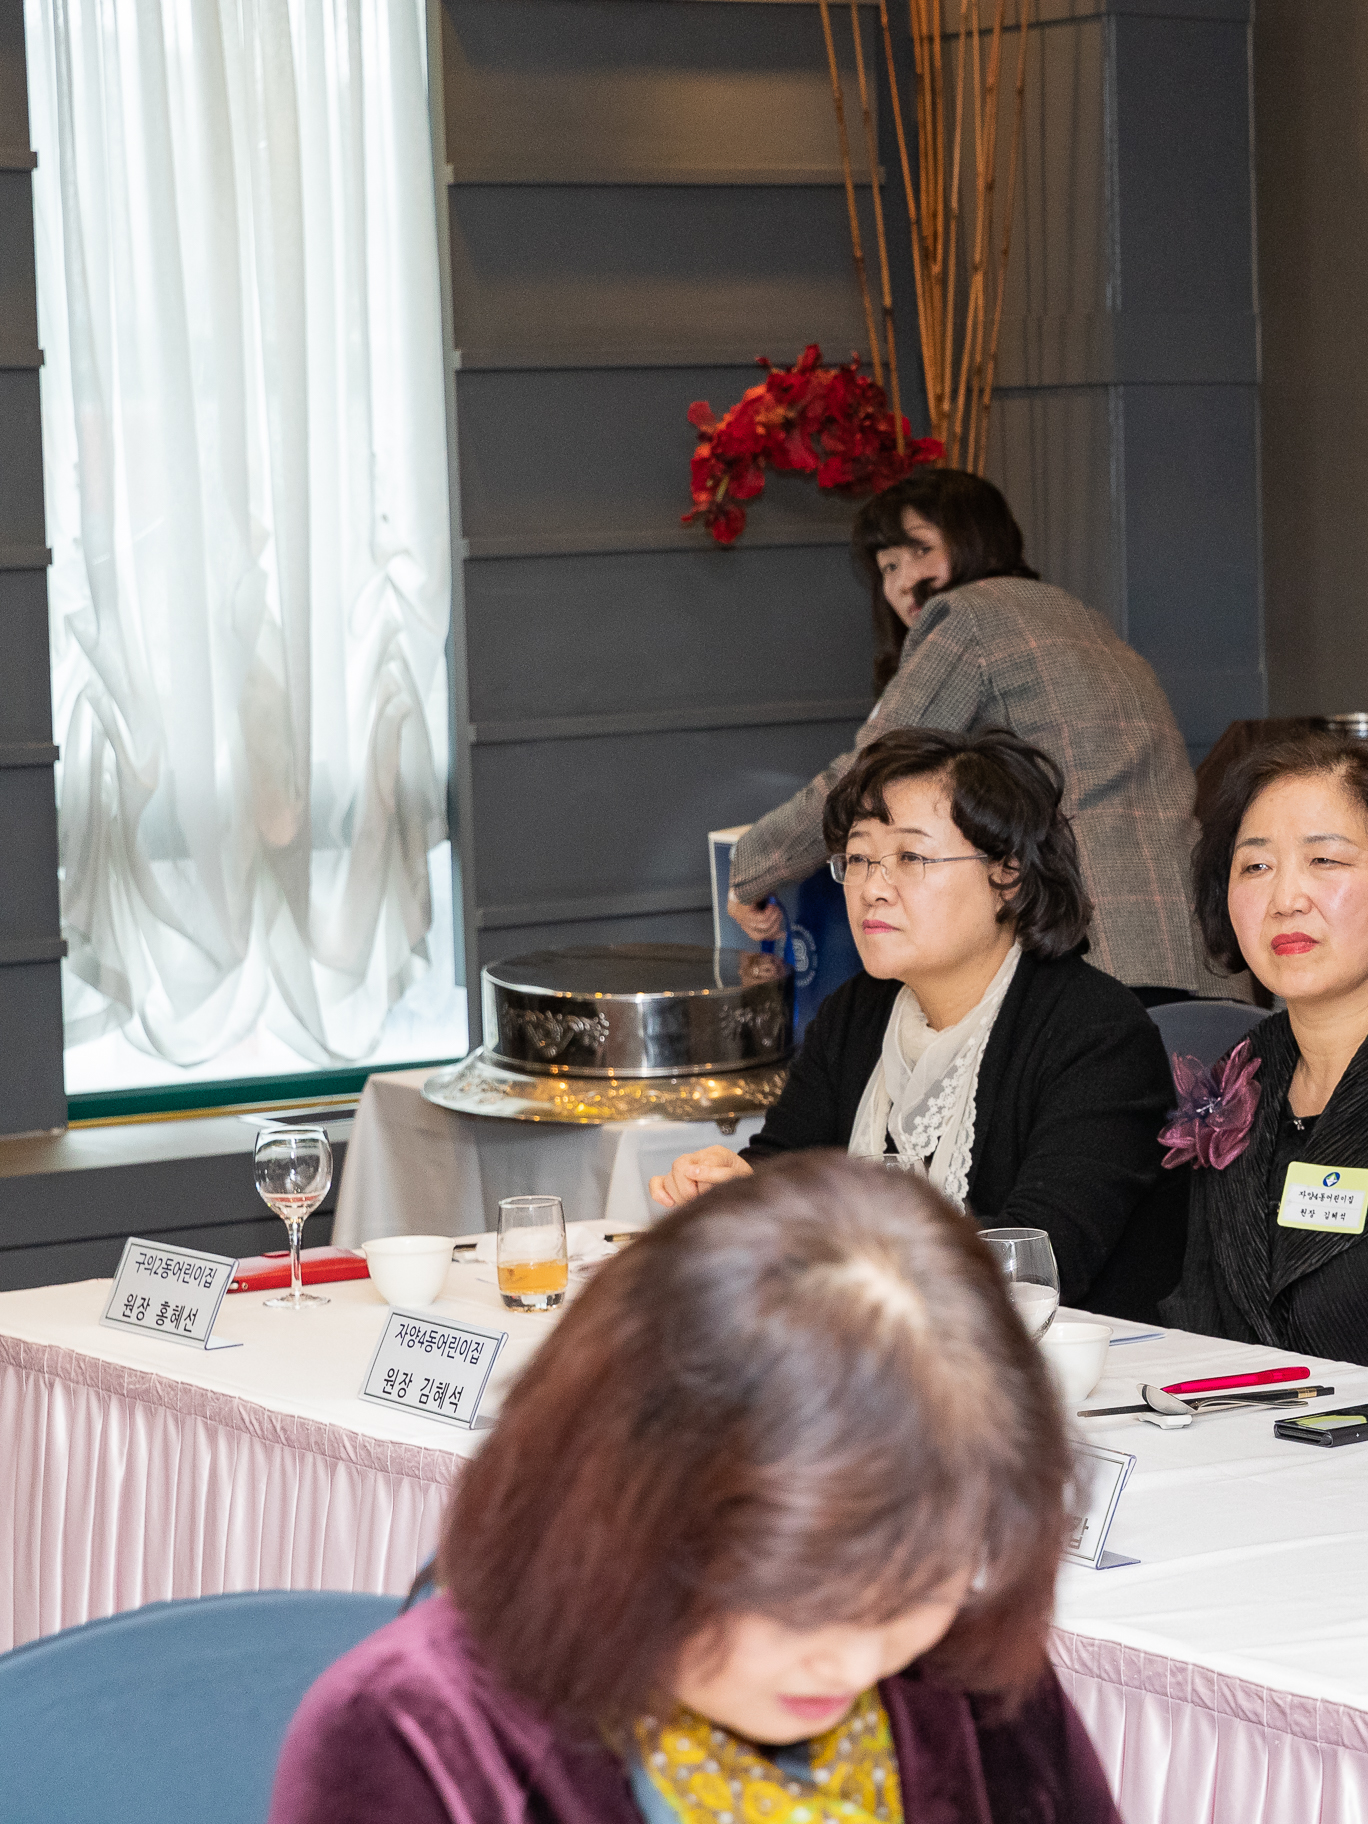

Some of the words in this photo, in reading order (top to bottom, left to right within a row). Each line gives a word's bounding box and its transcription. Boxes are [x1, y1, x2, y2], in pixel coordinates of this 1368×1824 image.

[1300, 1208, 1316, 1219] 원장
[135, 1252, 217, 1288] 구의2동어린이집
[122, 1293, 150, 1321] 원장
[155, 1300, 198, 1333] 홍혜선
[395, 1323, 485, 1365] 자양4동어린이집
[382, 1368, 413, 1398] 원장
[418, 1377, 464, 1414] 김혜석
